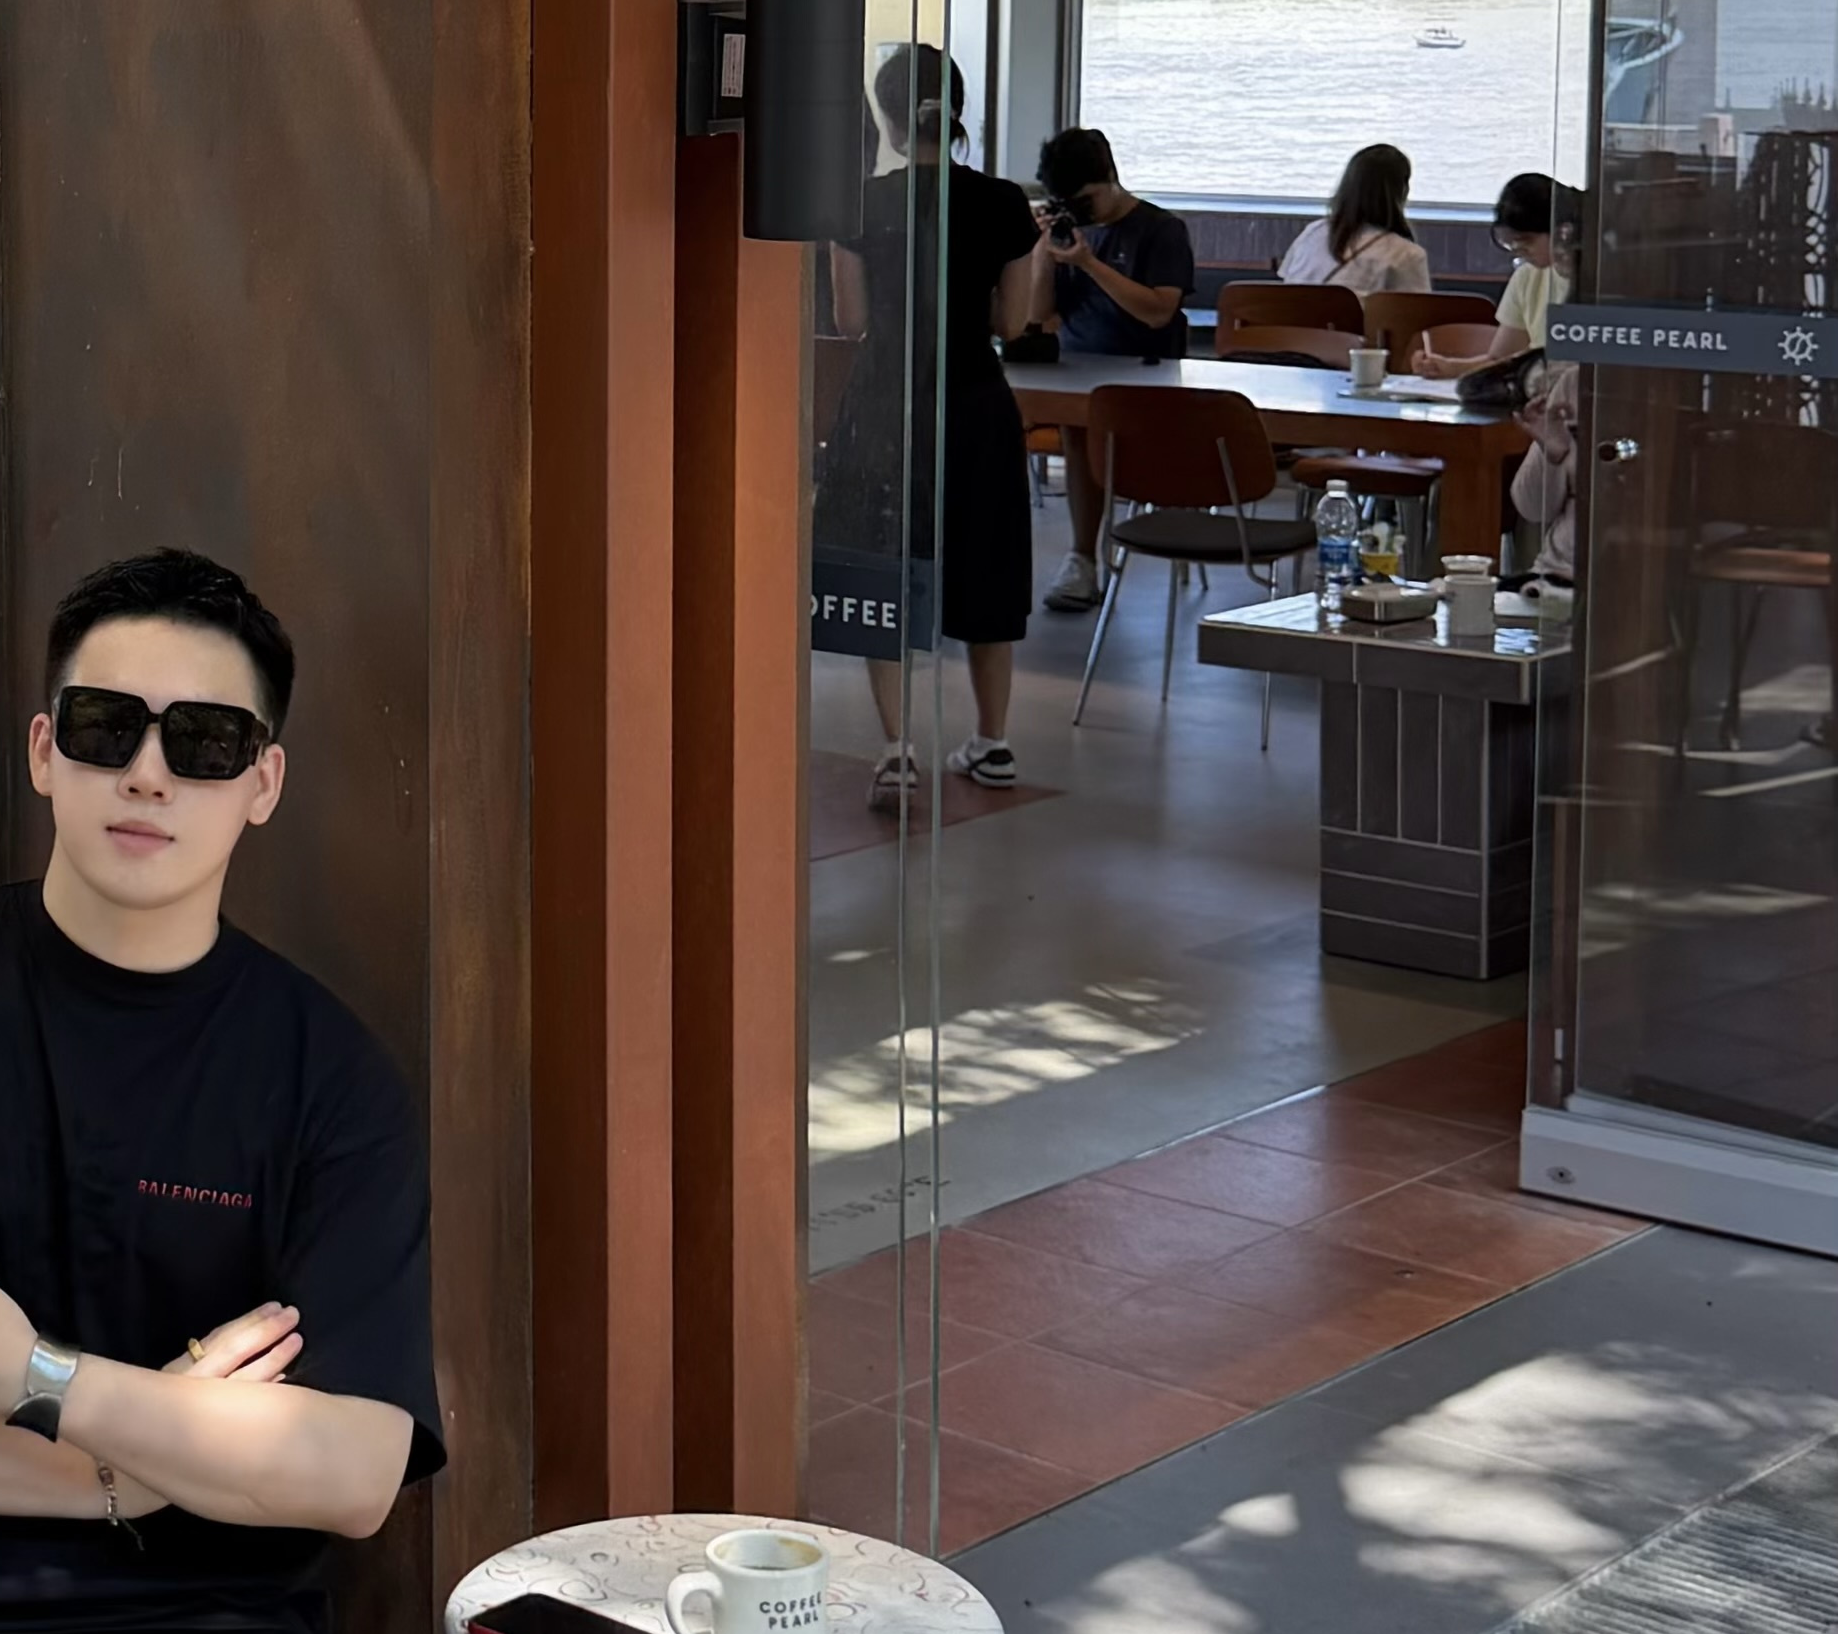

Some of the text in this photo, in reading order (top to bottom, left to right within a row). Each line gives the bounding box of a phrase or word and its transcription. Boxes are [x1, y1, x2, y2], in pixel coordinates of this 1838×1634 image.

[1550, 323, 1729, 351] COFFEE PEARL
[138, 1179, 253, 1209] BALENCIAGA
[759, 1591, 822, 1615] COFFEE
[768, 1609, 819, 1630] PEARL
